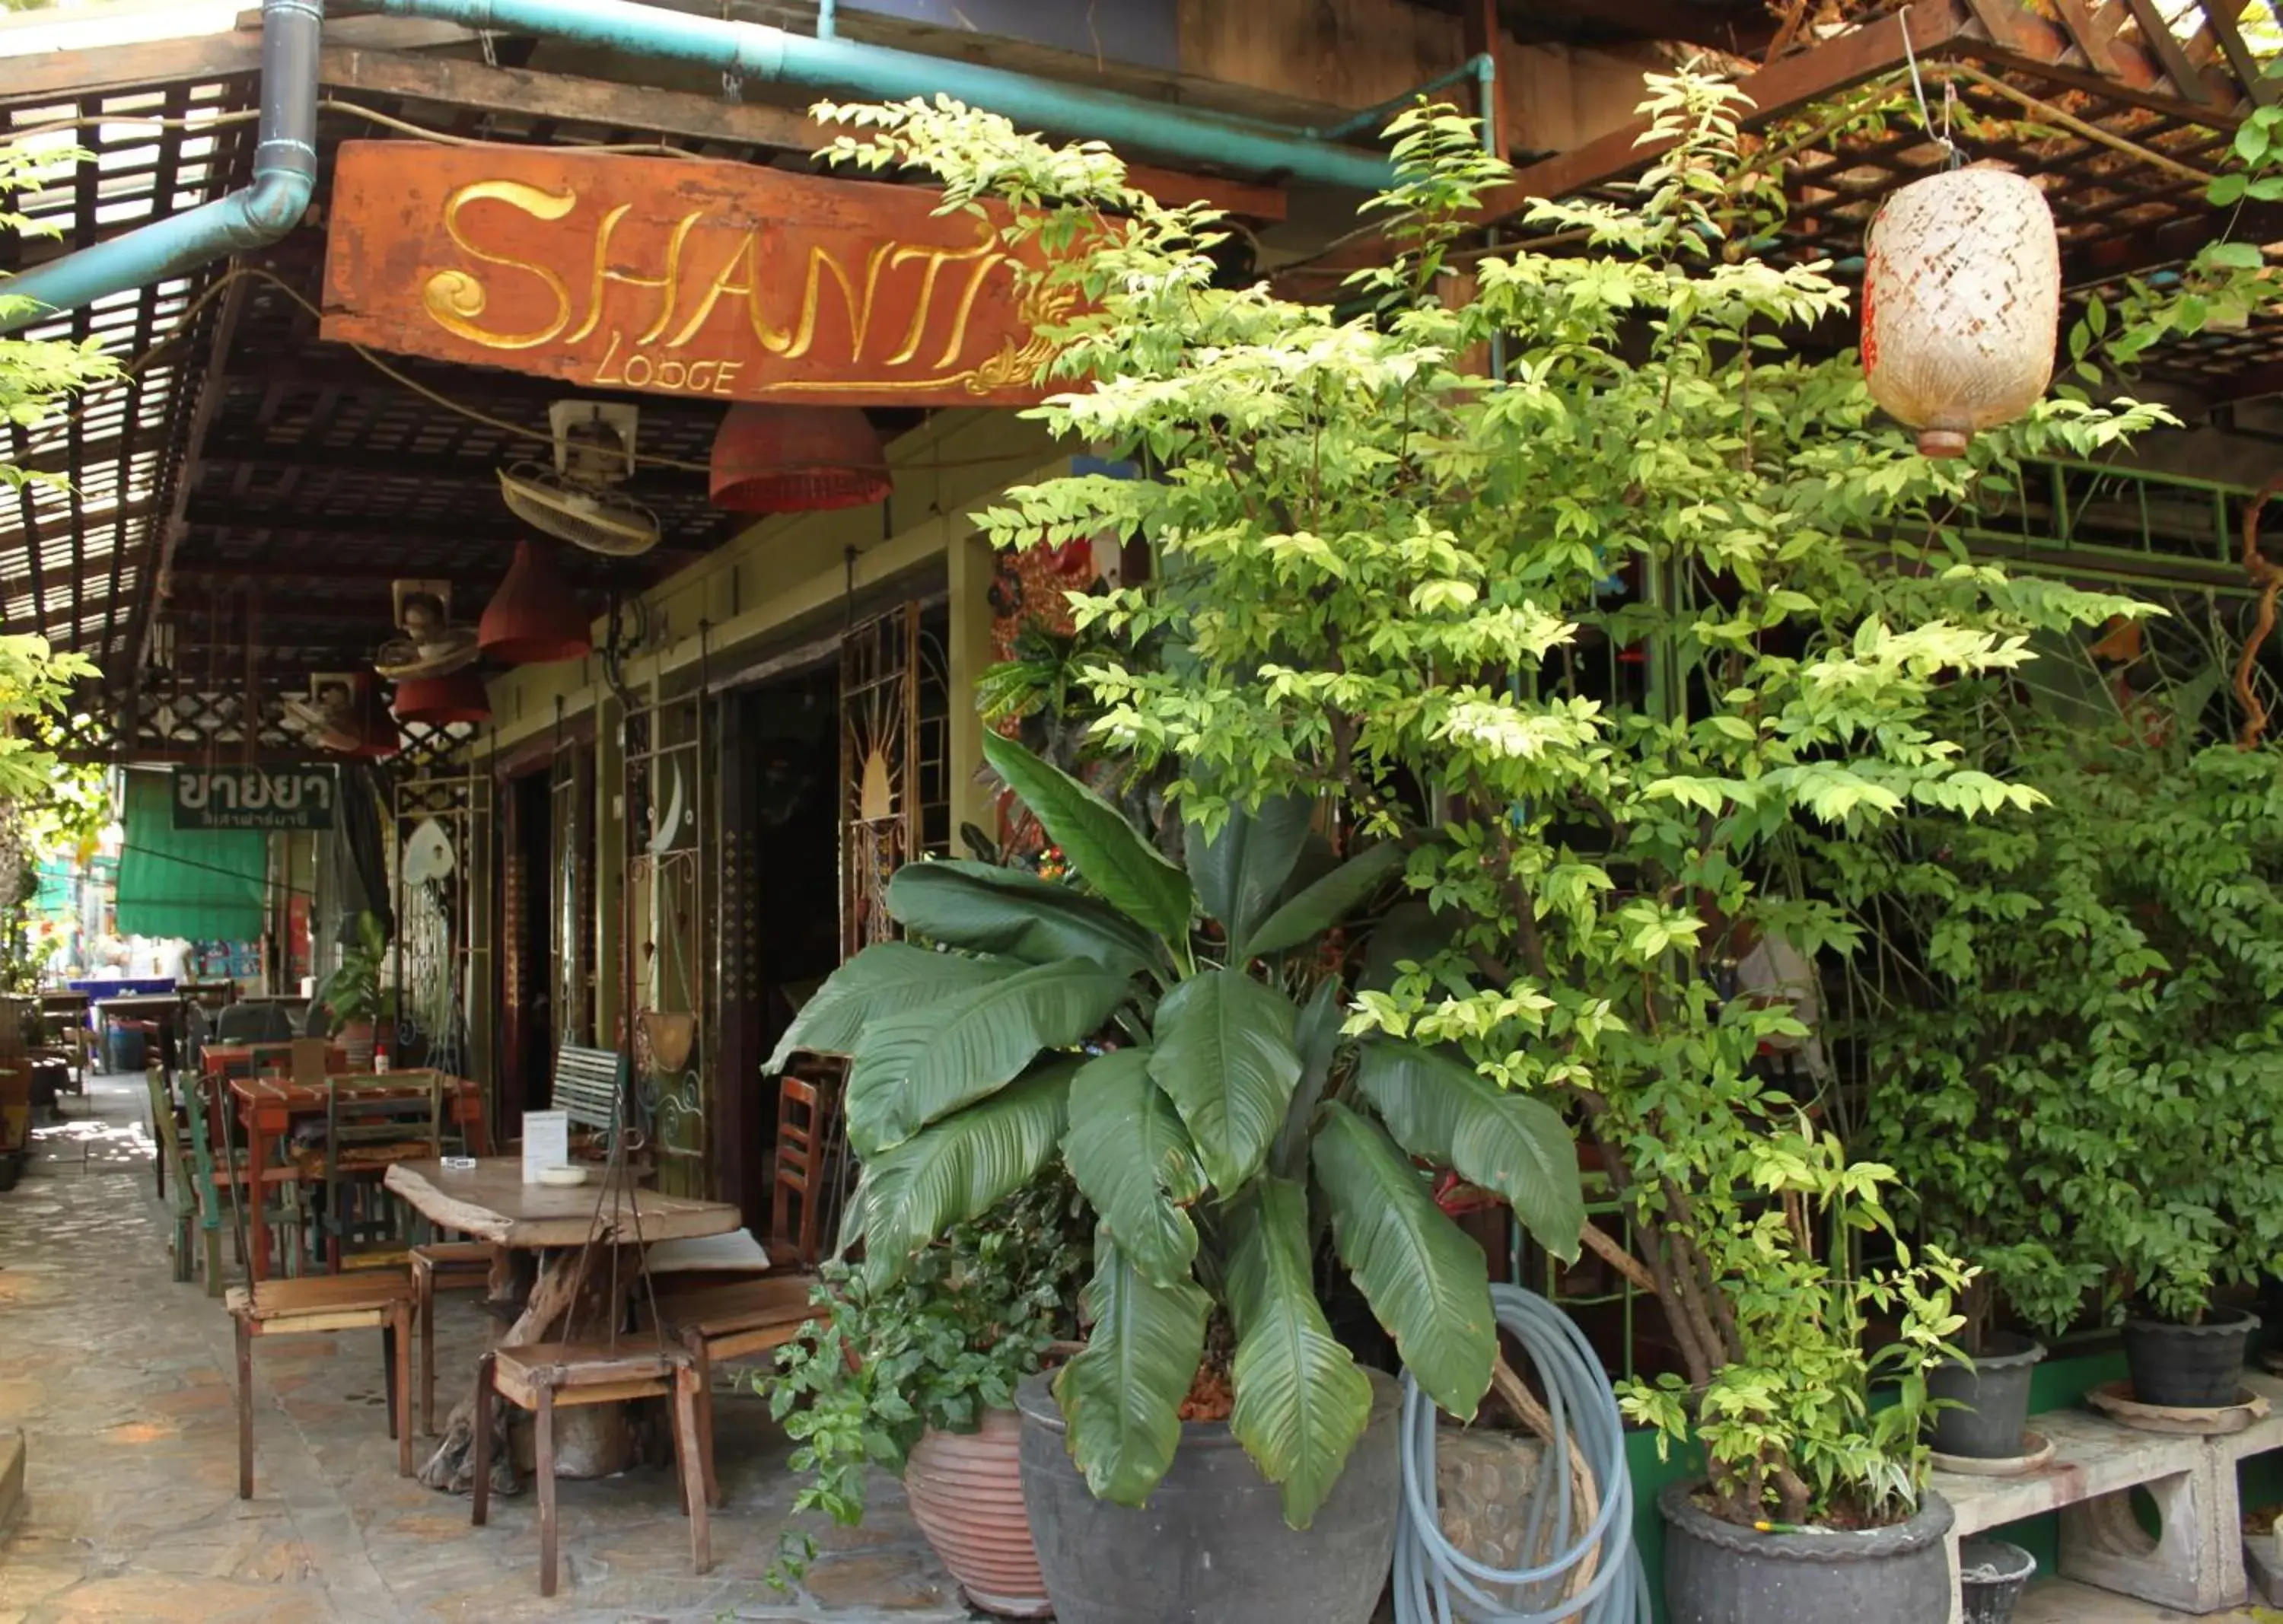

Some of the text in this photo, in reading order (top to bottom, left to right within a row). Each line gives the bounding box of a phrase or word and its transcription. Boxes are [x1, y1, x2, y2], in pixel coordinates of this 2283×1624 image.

[424, 178, 1007, 368] SHANTI
[594, 330, 743, 393] LODGE
[180, 775, 330, 809] ขายยา
